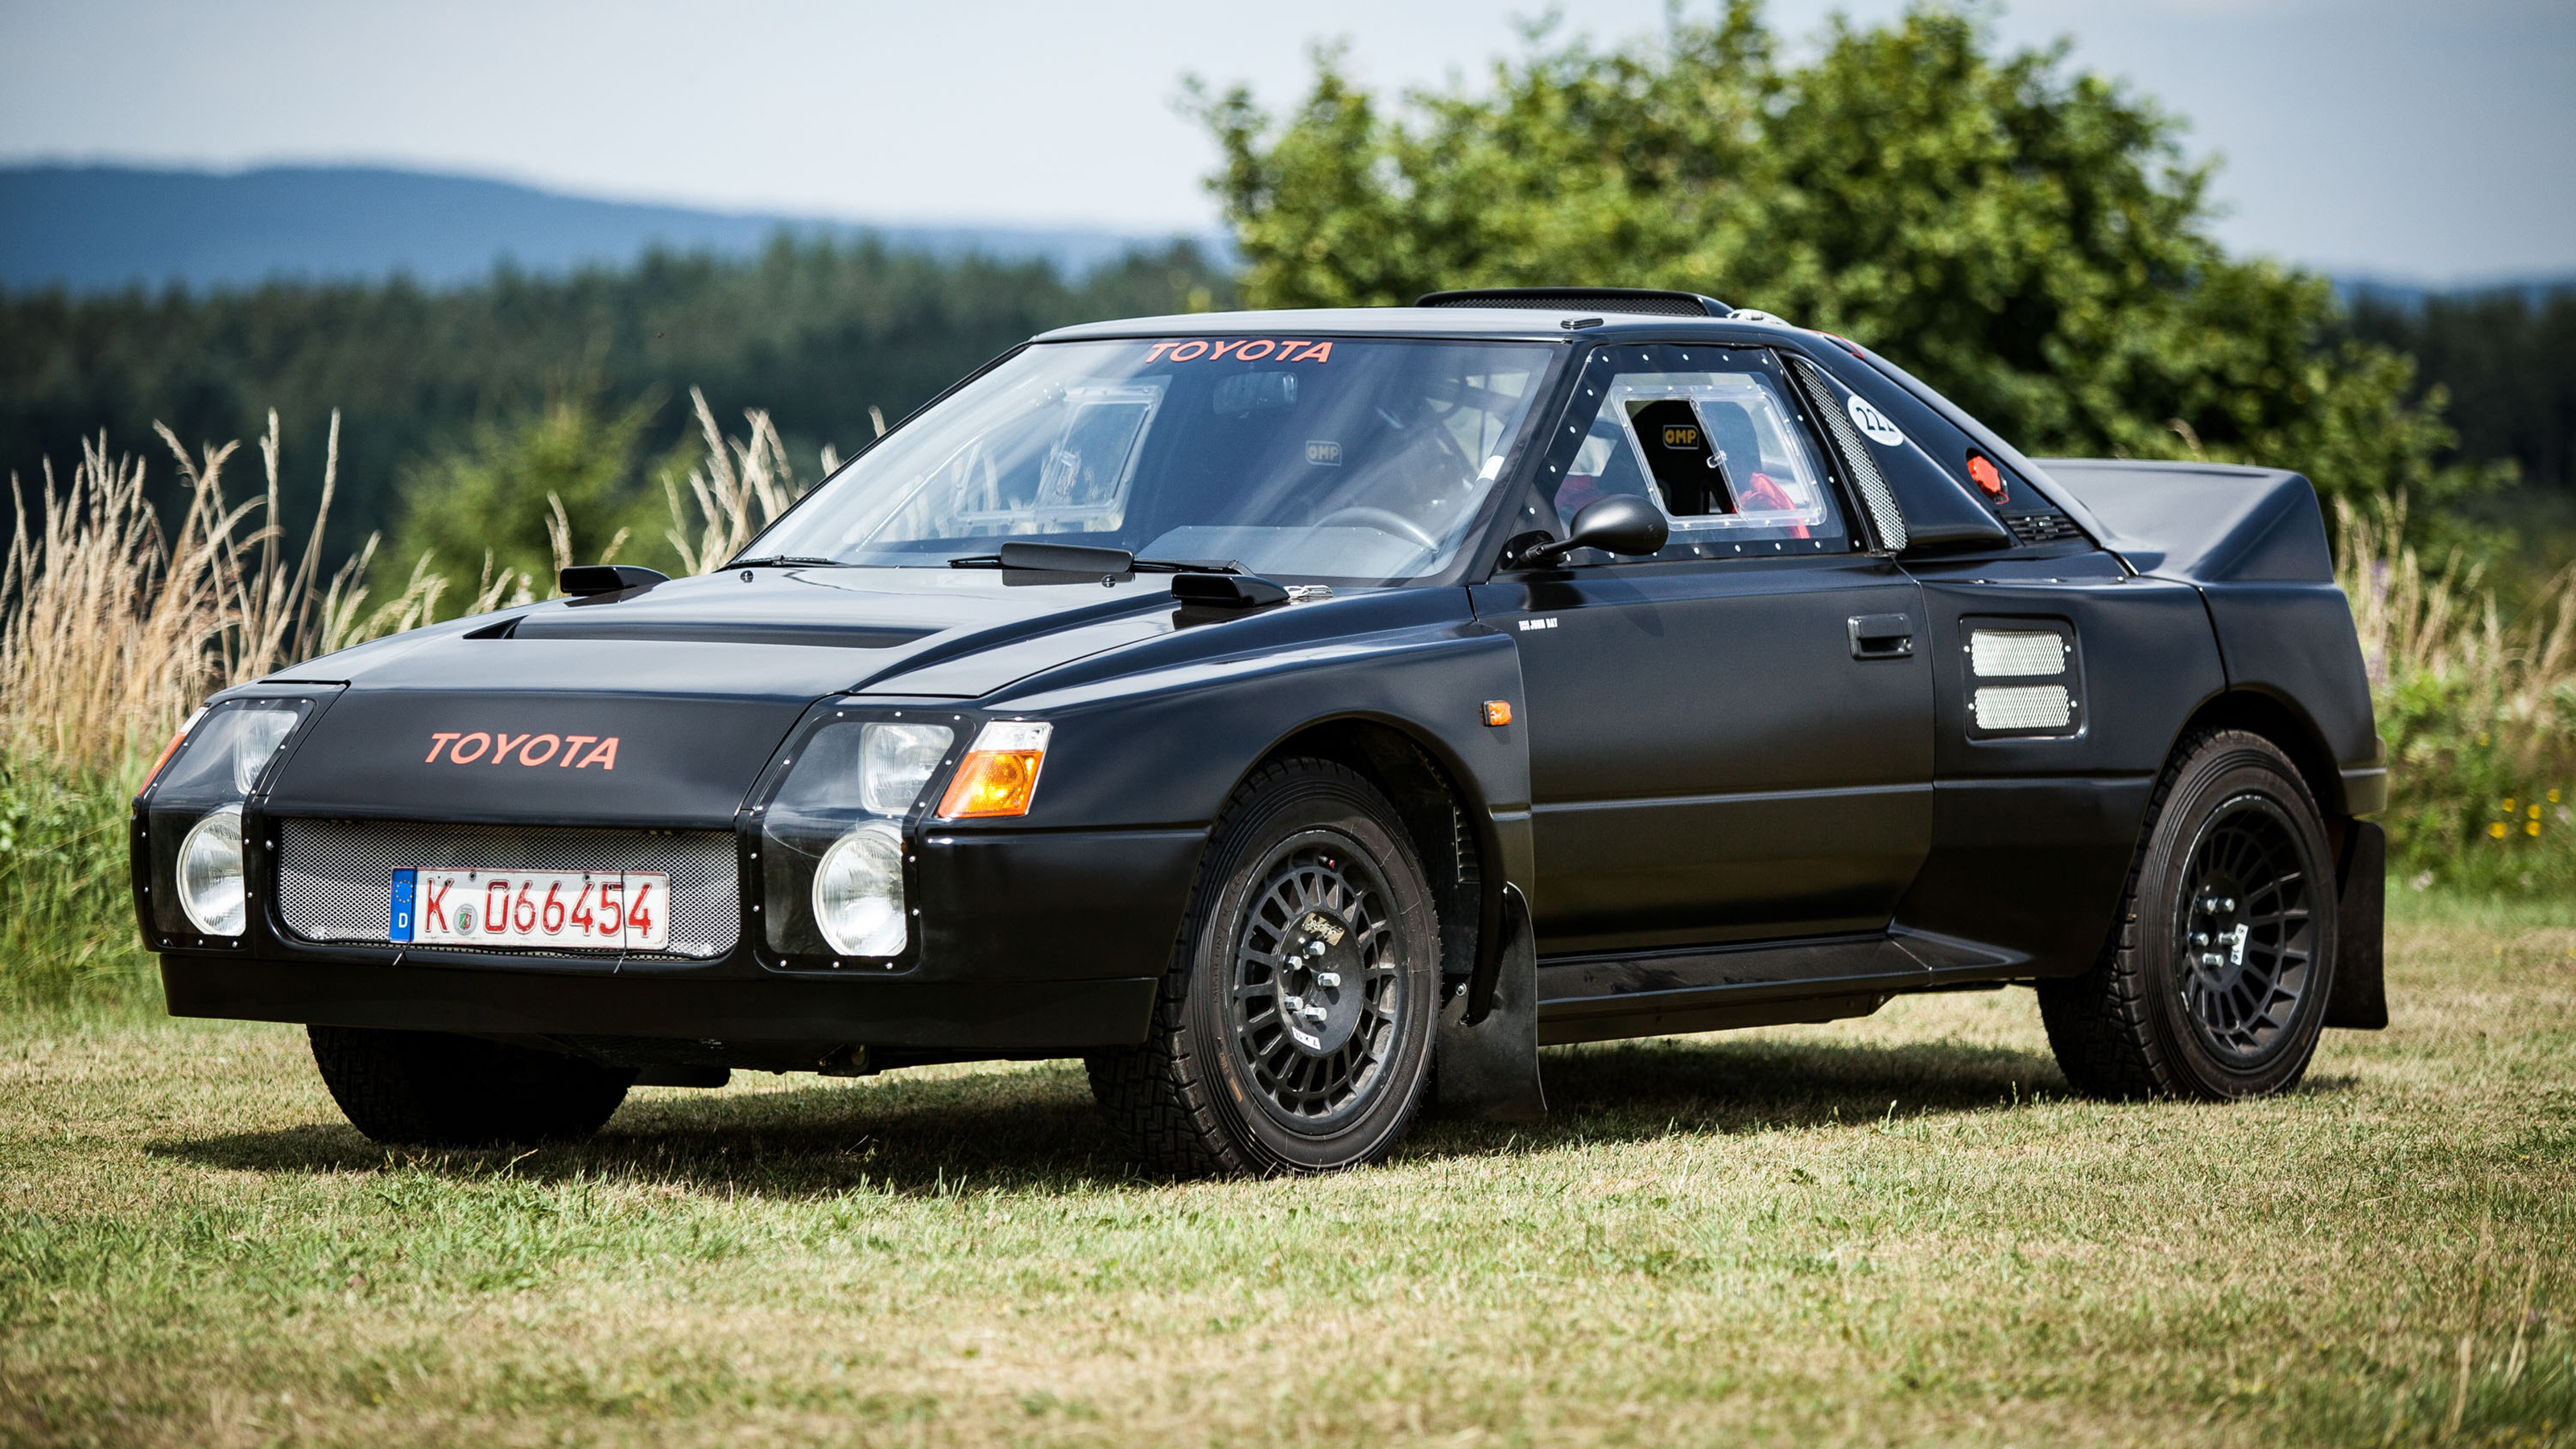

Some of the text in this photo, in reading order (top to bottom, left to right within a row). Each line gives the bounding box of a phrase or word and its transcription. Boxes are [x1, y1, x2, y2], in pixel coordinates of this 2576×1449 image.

[1145, 339, 1334, 363] TOYOTA
[1665, 429, 1697, 444] OMP
[1308, 445, 1340, 460] OMP
[425, 732, 619, 770] TOYOTA
[425, 877, 654, 938] K 066454
[398, 912, 408, 928] D
